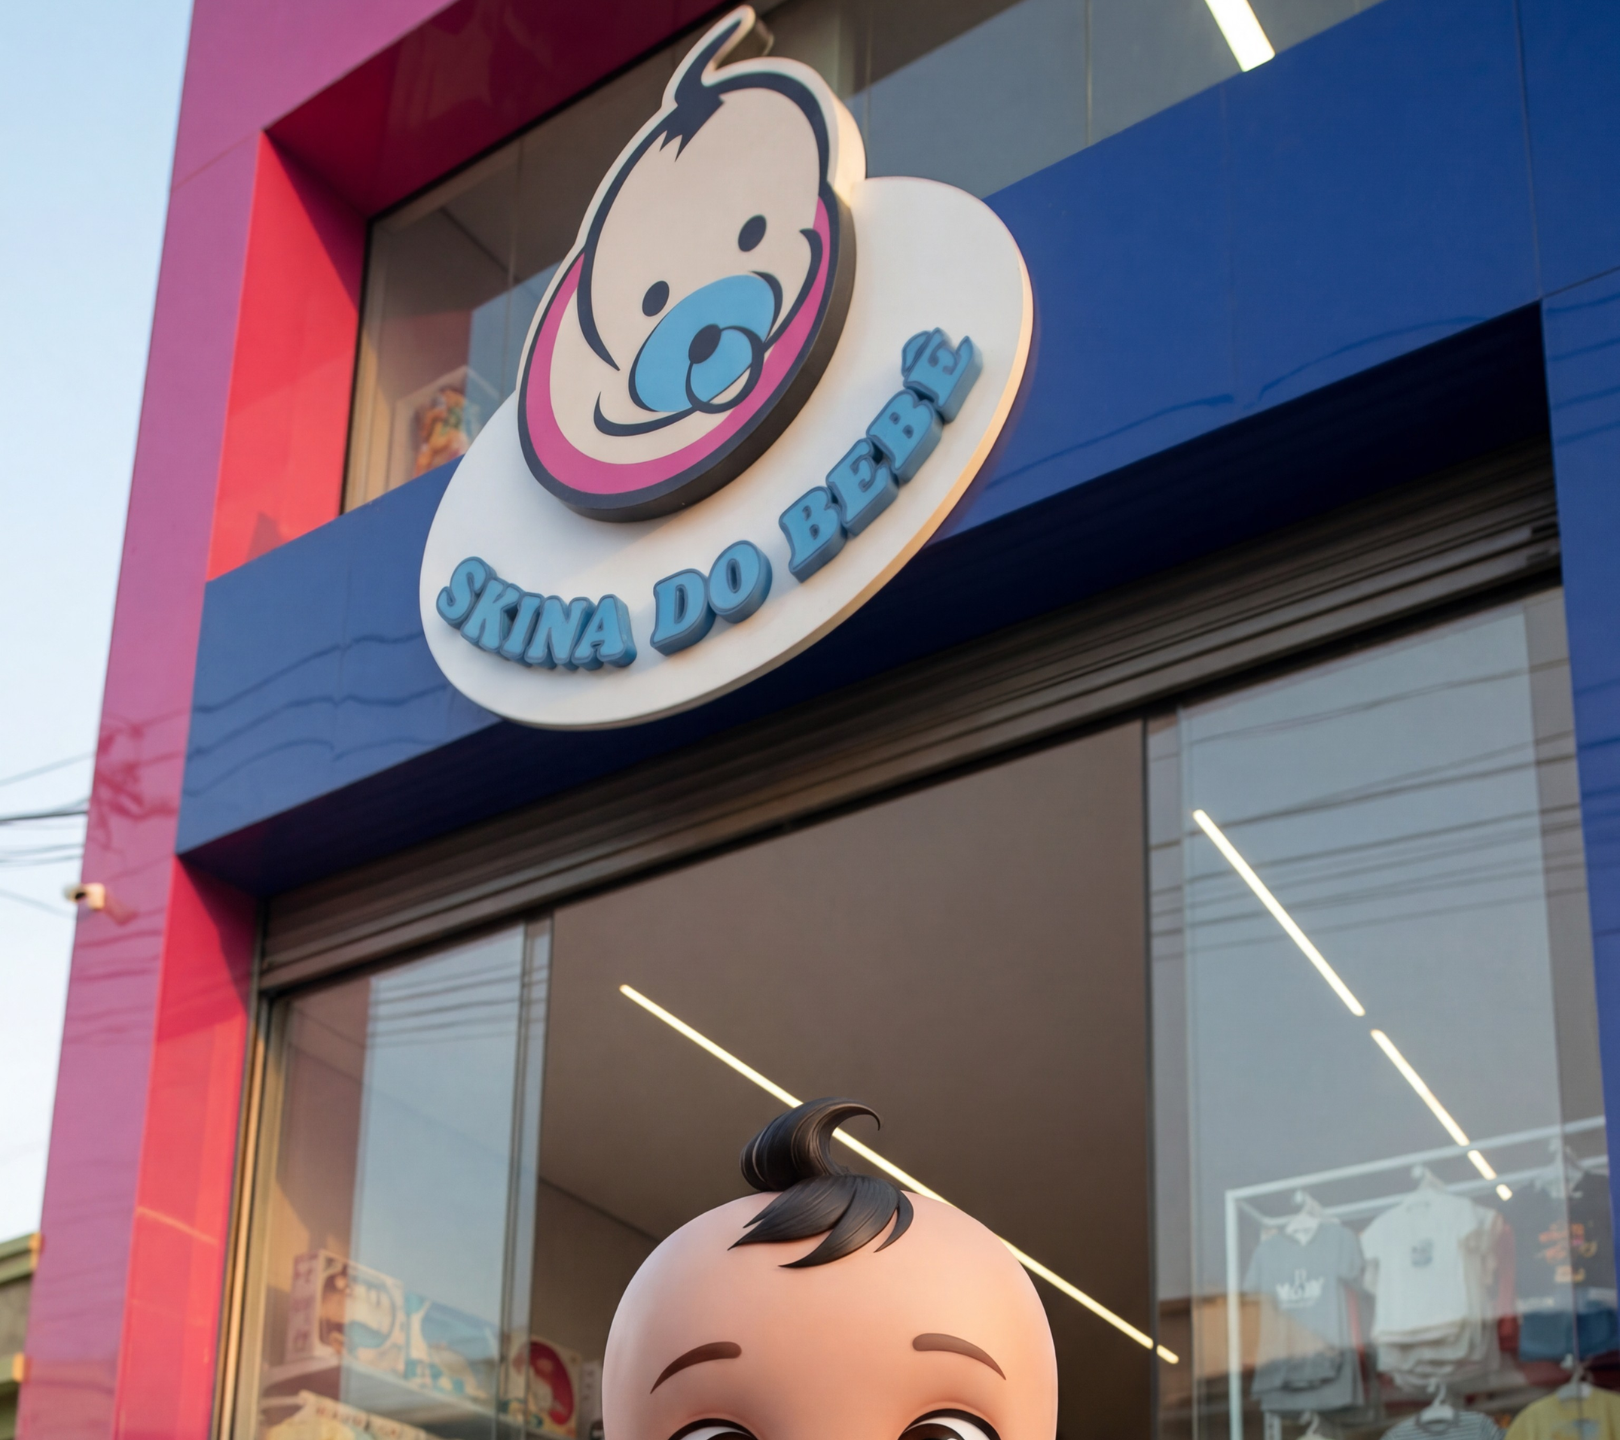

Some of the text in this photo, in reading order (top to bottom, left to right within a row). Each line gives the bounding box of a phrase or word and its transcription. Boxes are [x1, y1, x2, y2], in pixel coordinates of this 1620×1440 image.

[437, 327, 982, 670] SKINA DO BEBÊ
